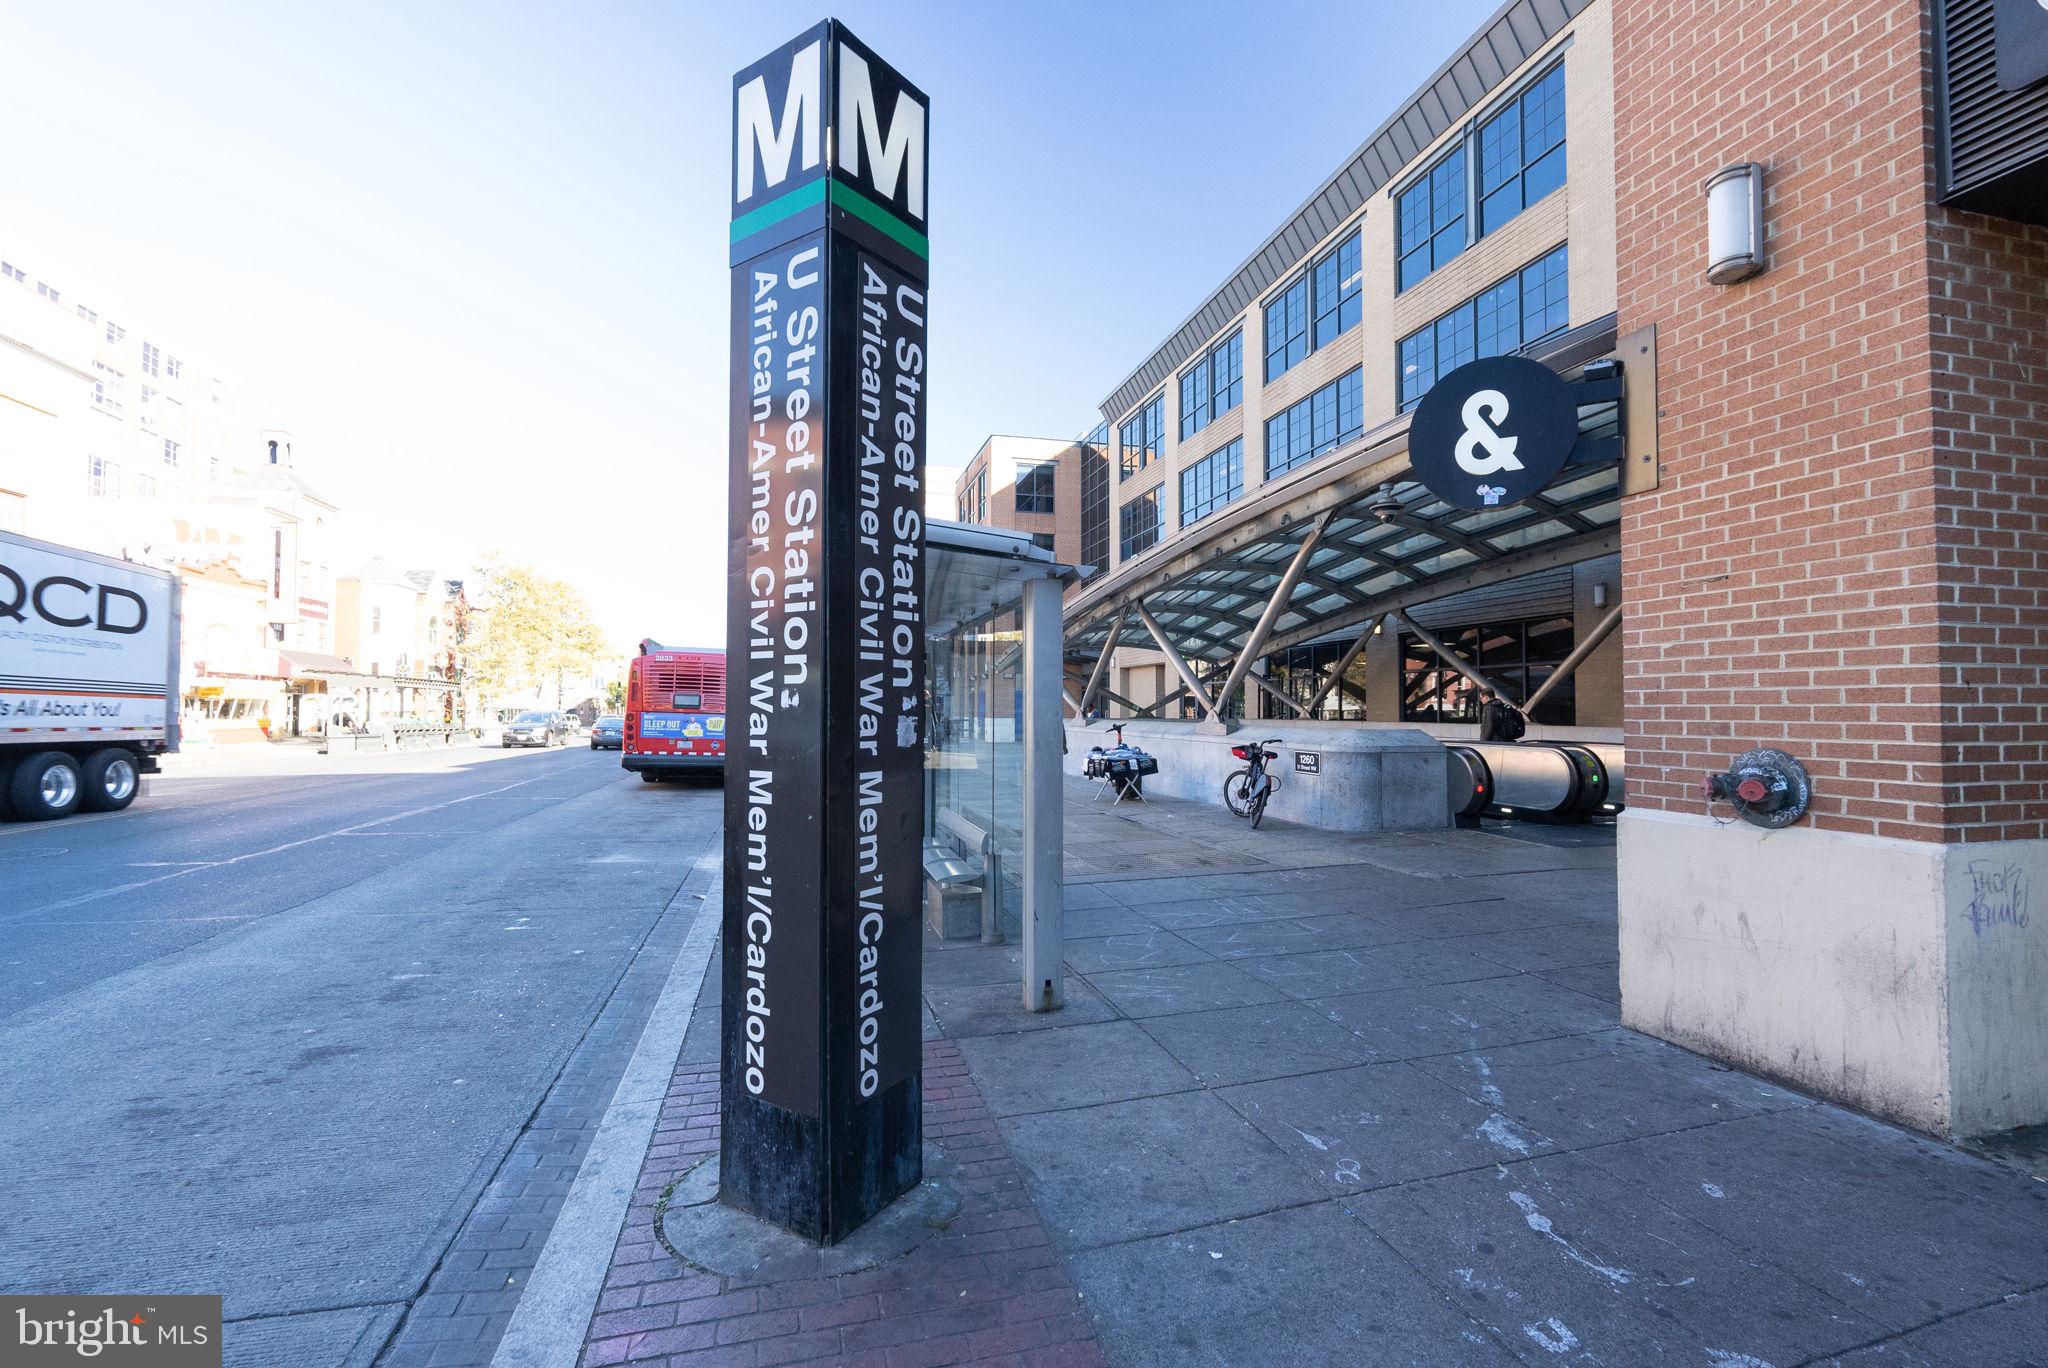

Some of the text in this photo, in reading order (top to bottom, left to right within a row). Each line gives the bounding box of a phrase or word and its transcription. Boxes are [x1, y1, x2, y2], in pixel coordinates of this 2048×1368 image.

[737, 39, 821, 203] M
[838, 40, 925, 222] M
[783, 246, 819, 685] U Street Station
[892, 284, 924, 687] U Street Station
[1454, 389, 1526, 476] &
[12, 699, 40, 717] All
[40, 701, 88, 717] About
[92, 701, 122, 717] You!
[643, 720, 681, 728] SLEEP OUT
[745, 271, 778, 1096] African-Amer Civil War Mem'l/Cardozo
[858, 262, 888, 1098] African-Amer Civil War Mem'l/Cardozo
[1300, 754, 1314, 764] 1260
